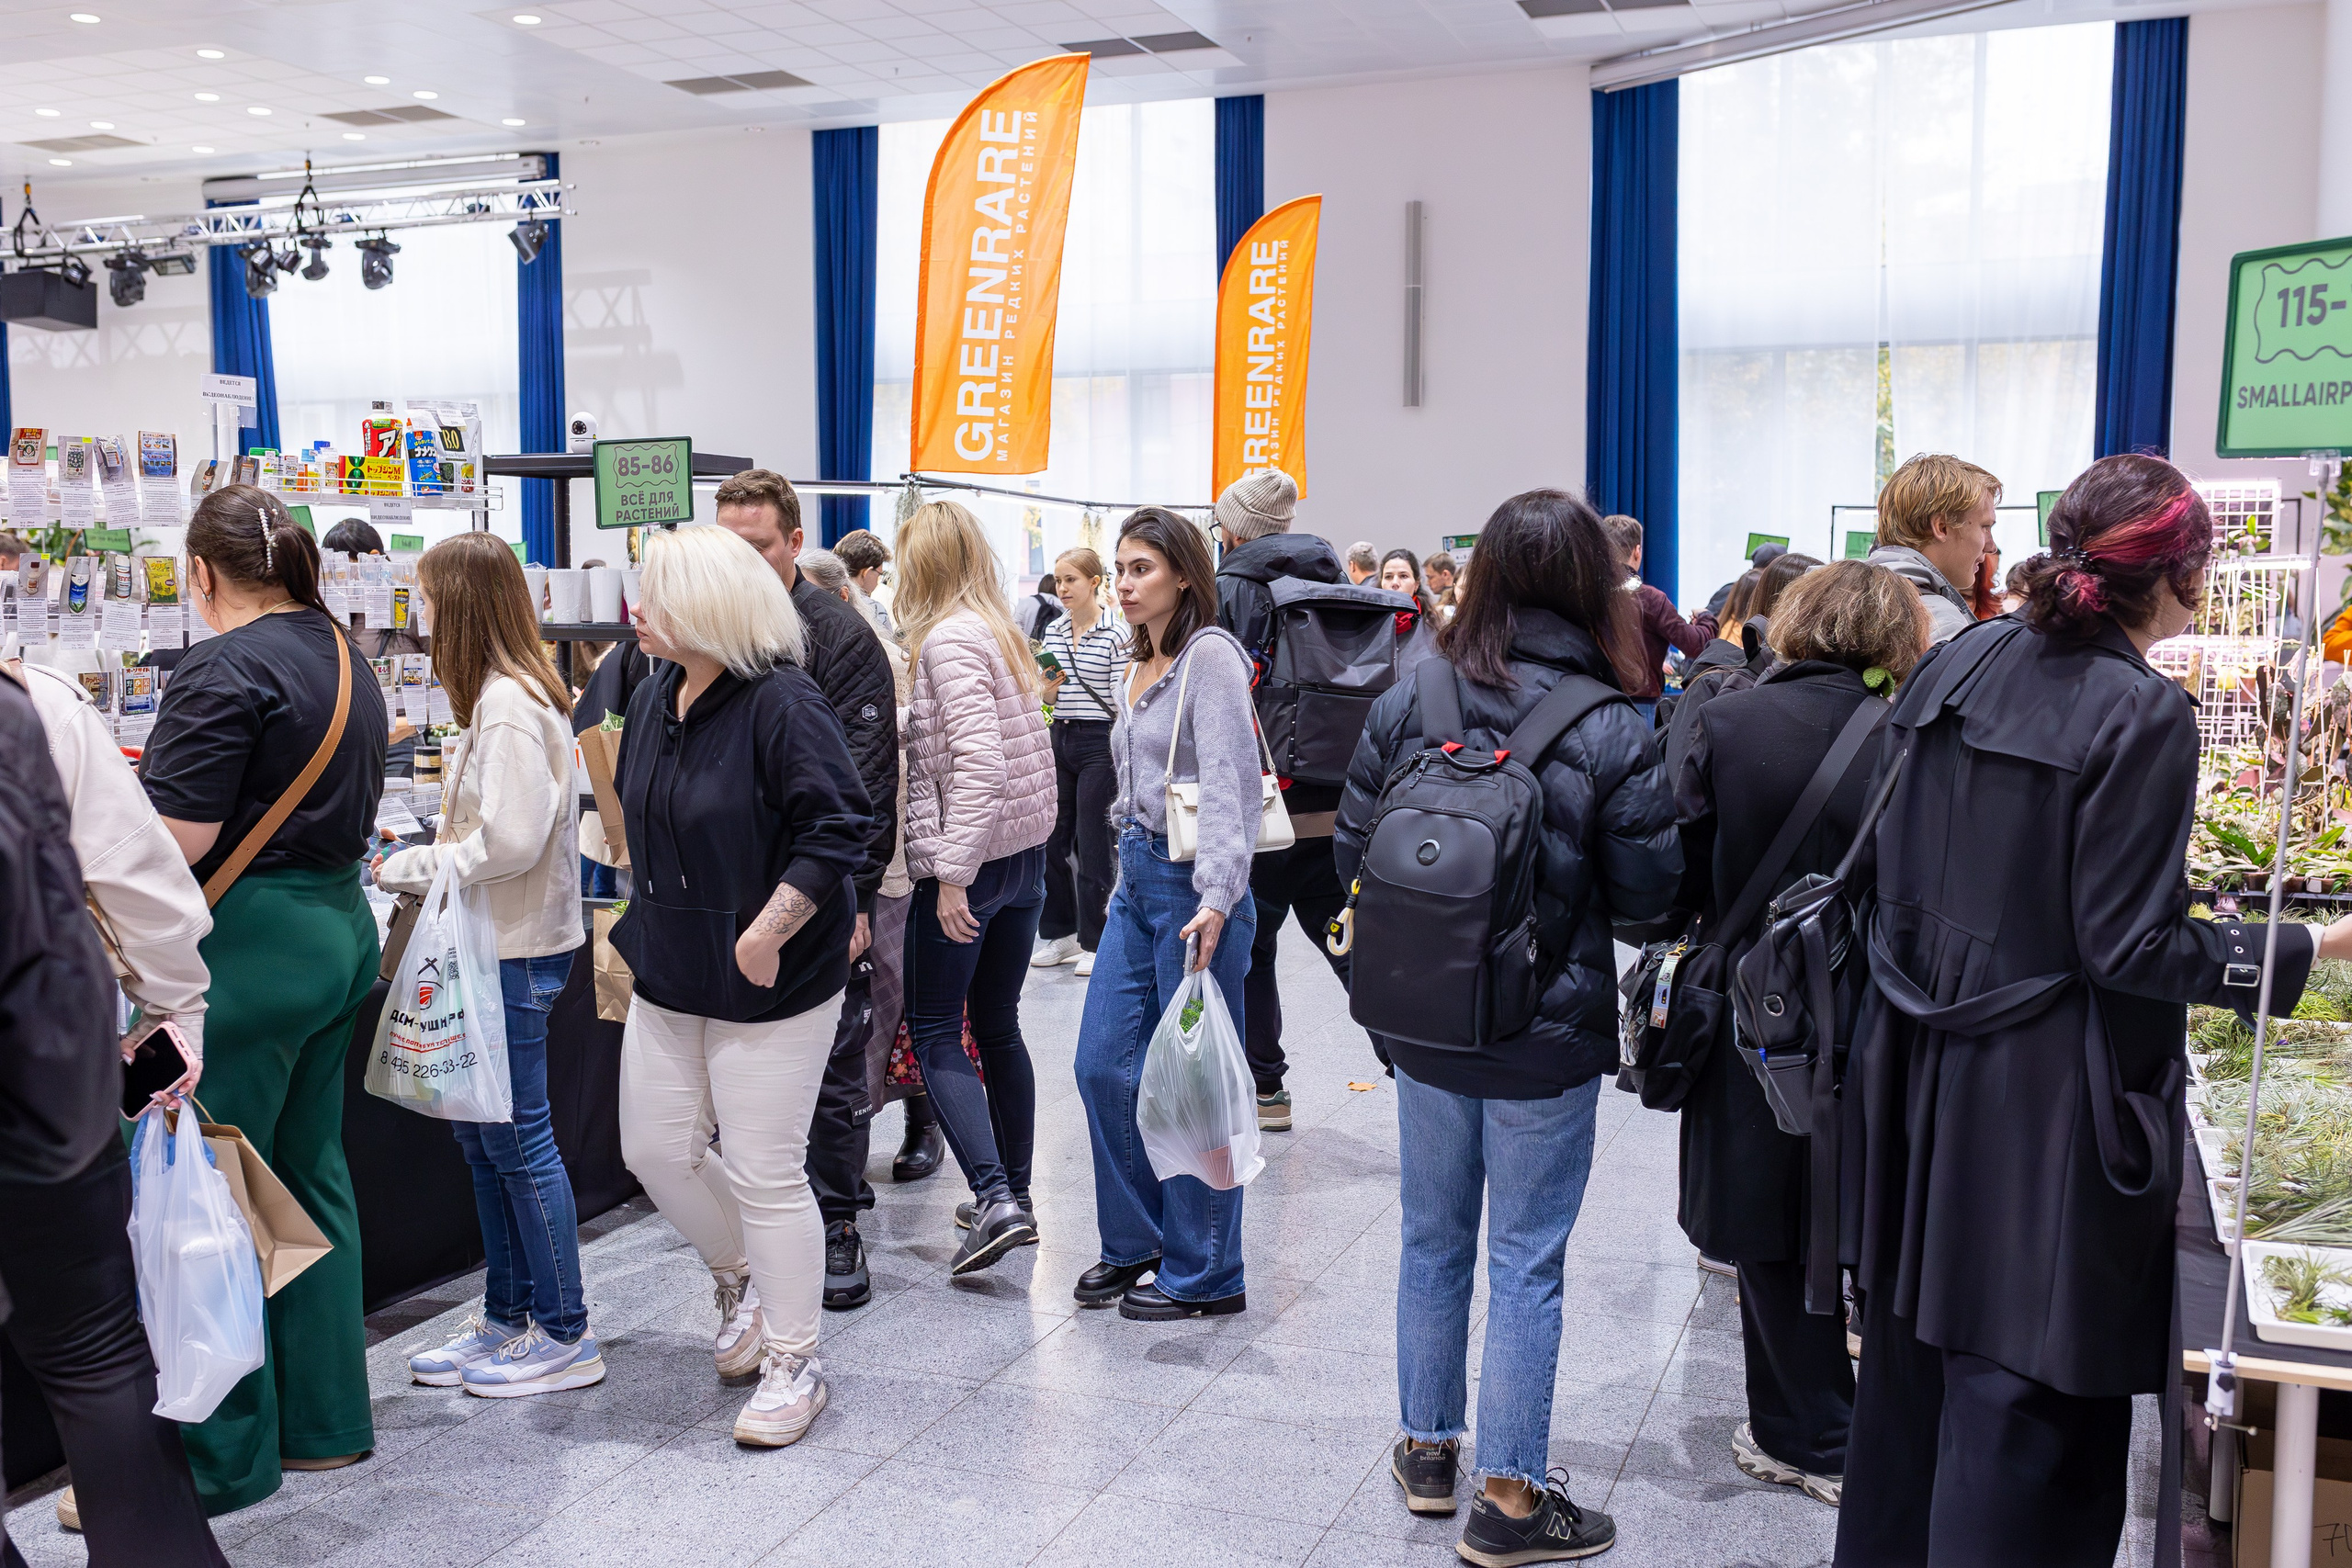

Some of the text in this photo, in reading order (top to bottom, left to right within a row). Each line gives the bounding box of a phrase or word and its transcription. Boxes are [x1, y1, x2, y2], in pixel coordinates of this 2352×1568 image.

[954, 109, 1022, 461] GREENRARE
[996, 111, 1038, 461] МАГАЗИН РЕДКИХ РАСТЕНИЙ
[1277, 239, 1289, 329] РАСТЕНИЙ
[2277, 283, 2352, 328] 115-
[1272, 340, 1286, 407] РЕДКИХ
[367, 465, 401, 475] トップジンM
[617, 455, 674, 477] 85-86
[616, 502, 680, 522] РАСТЕНИЙ
[620, 491, 674, 507] ВСЁ ДЛЯ
[380, 1050, 478, 1079] 8 495 226-33-22
